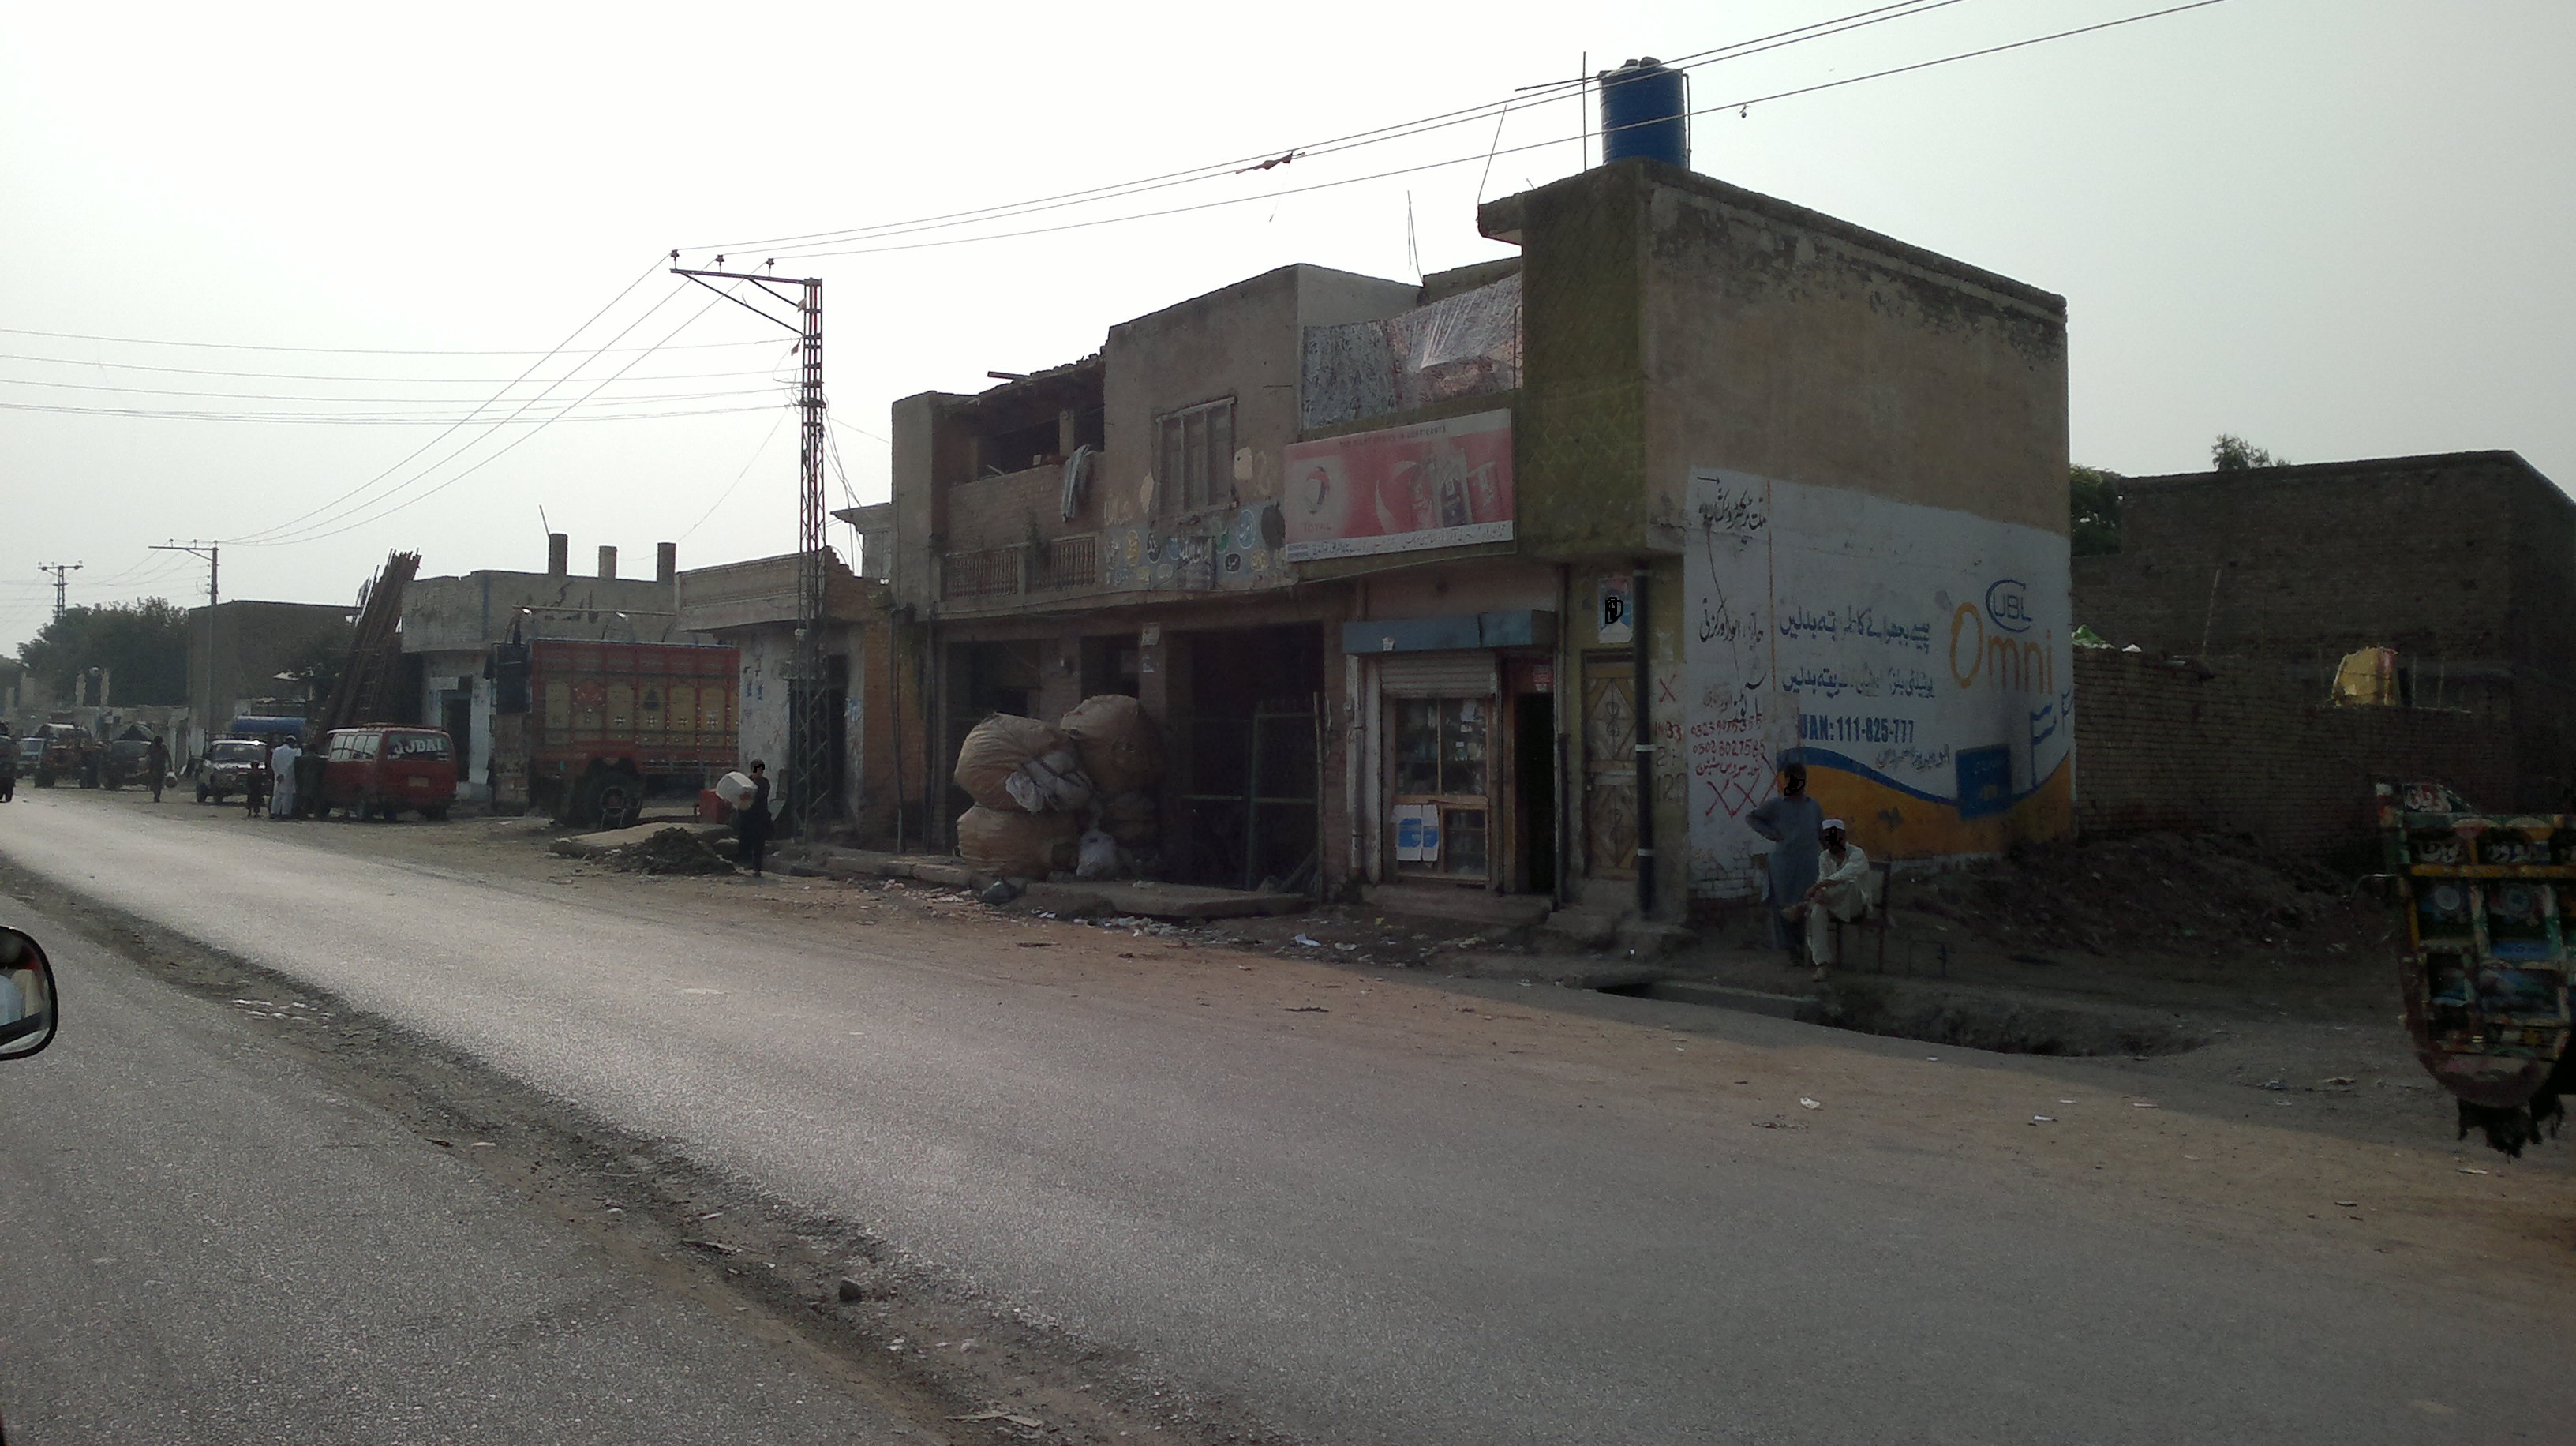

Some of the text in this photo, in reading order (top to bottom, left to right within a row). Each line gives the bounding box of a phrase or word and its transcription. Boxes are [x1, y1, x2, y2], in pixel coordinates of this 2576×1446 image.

[1302, 522, 1332, 533] TOTAL
[1993, 592, 2033, 622] UBL
[1949, 601, 2054, 695] Omni
[1799, 714, 1915, 744] UAN: 111-825-777
